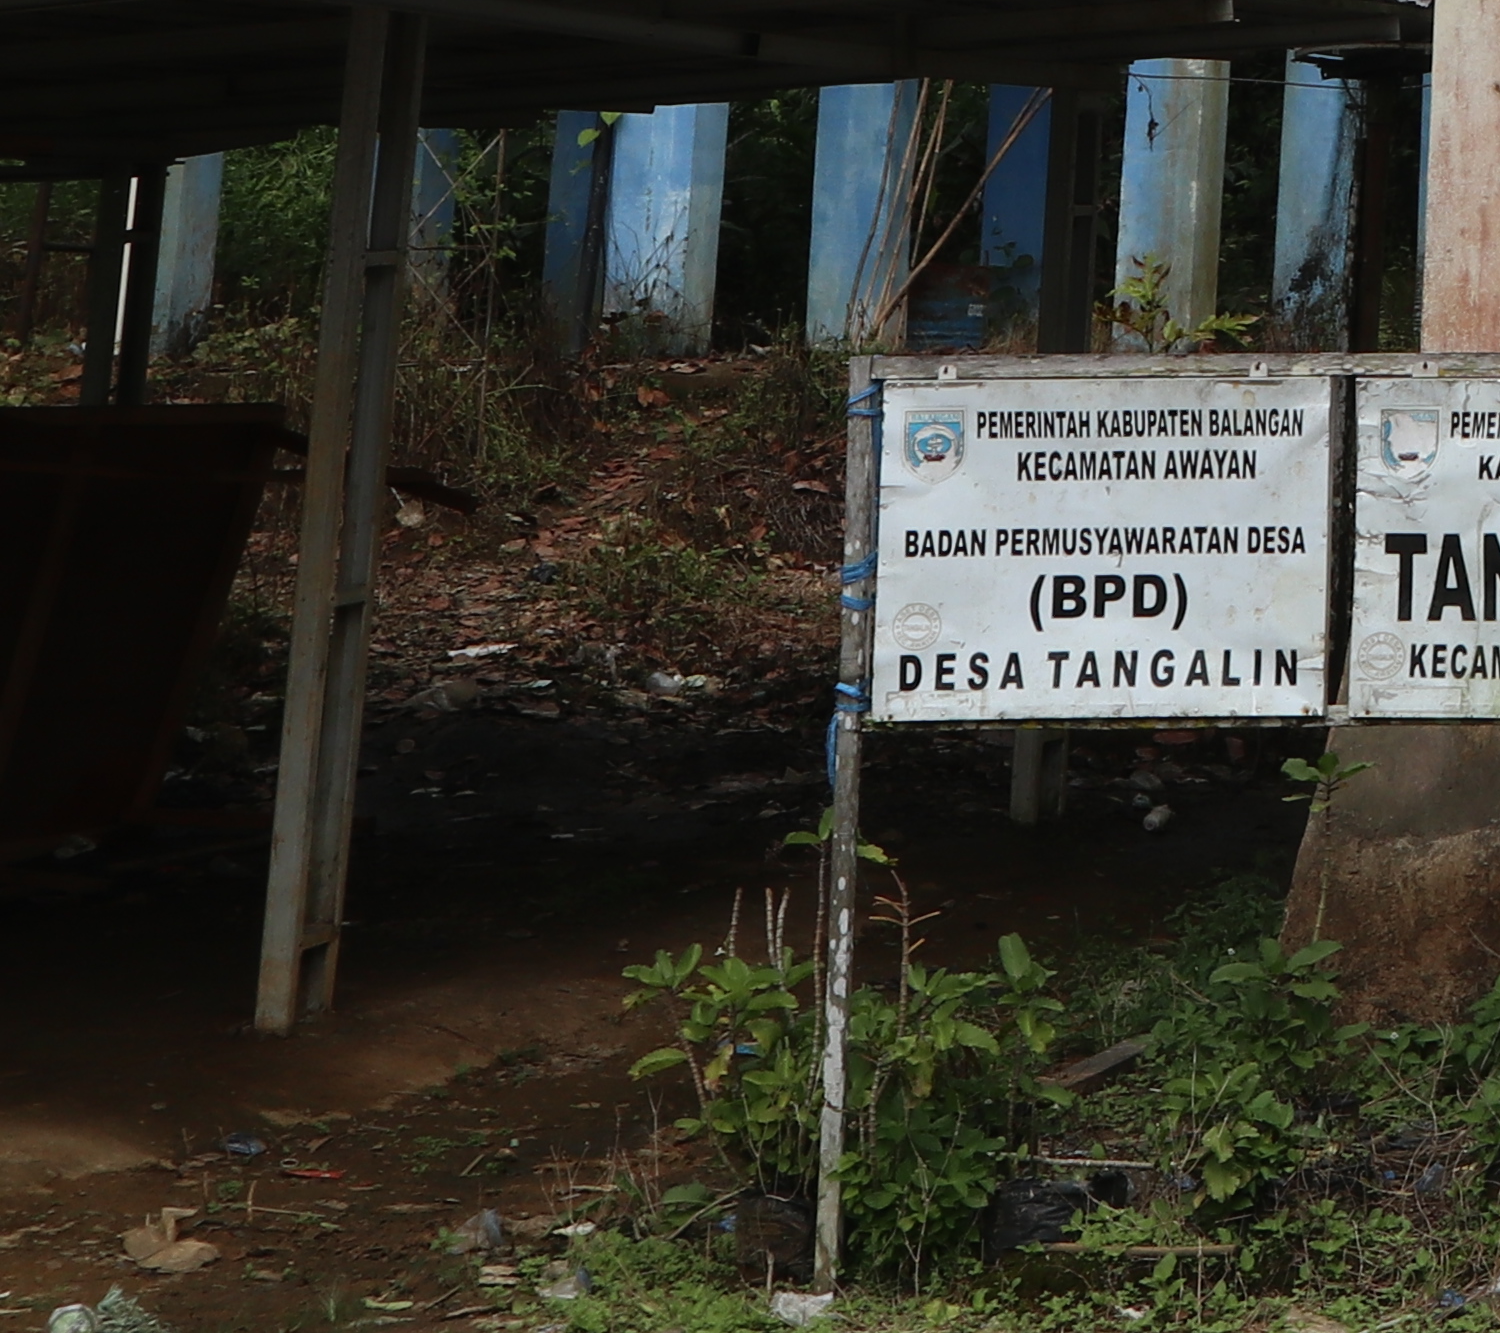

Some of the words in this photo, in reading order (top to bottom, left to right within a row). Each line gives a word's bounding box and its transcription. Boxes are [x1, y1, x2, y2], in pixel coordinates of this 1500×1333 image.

[977, 409, 1090, 439] PEMERINTAH
[1097, 409, 1203, 438] KABUPATEN
[1208, 408, 1304, 437] BALANGAN
[1016, 450, 1156, 482] KECAMATAN
[1163, 450, 1257, 480] AWAYAN
[904, 529, 986, 558] BADAN
[995, 527, 1239, 556] PERMUSYAWARATAN
[1246, 526, 1306, 554] DESA
[1029, 573, 1188, 632] (BPD)
[900, 651, 1025, 692] DESA
[1047, 649, 1299, 688] TANGALIN
